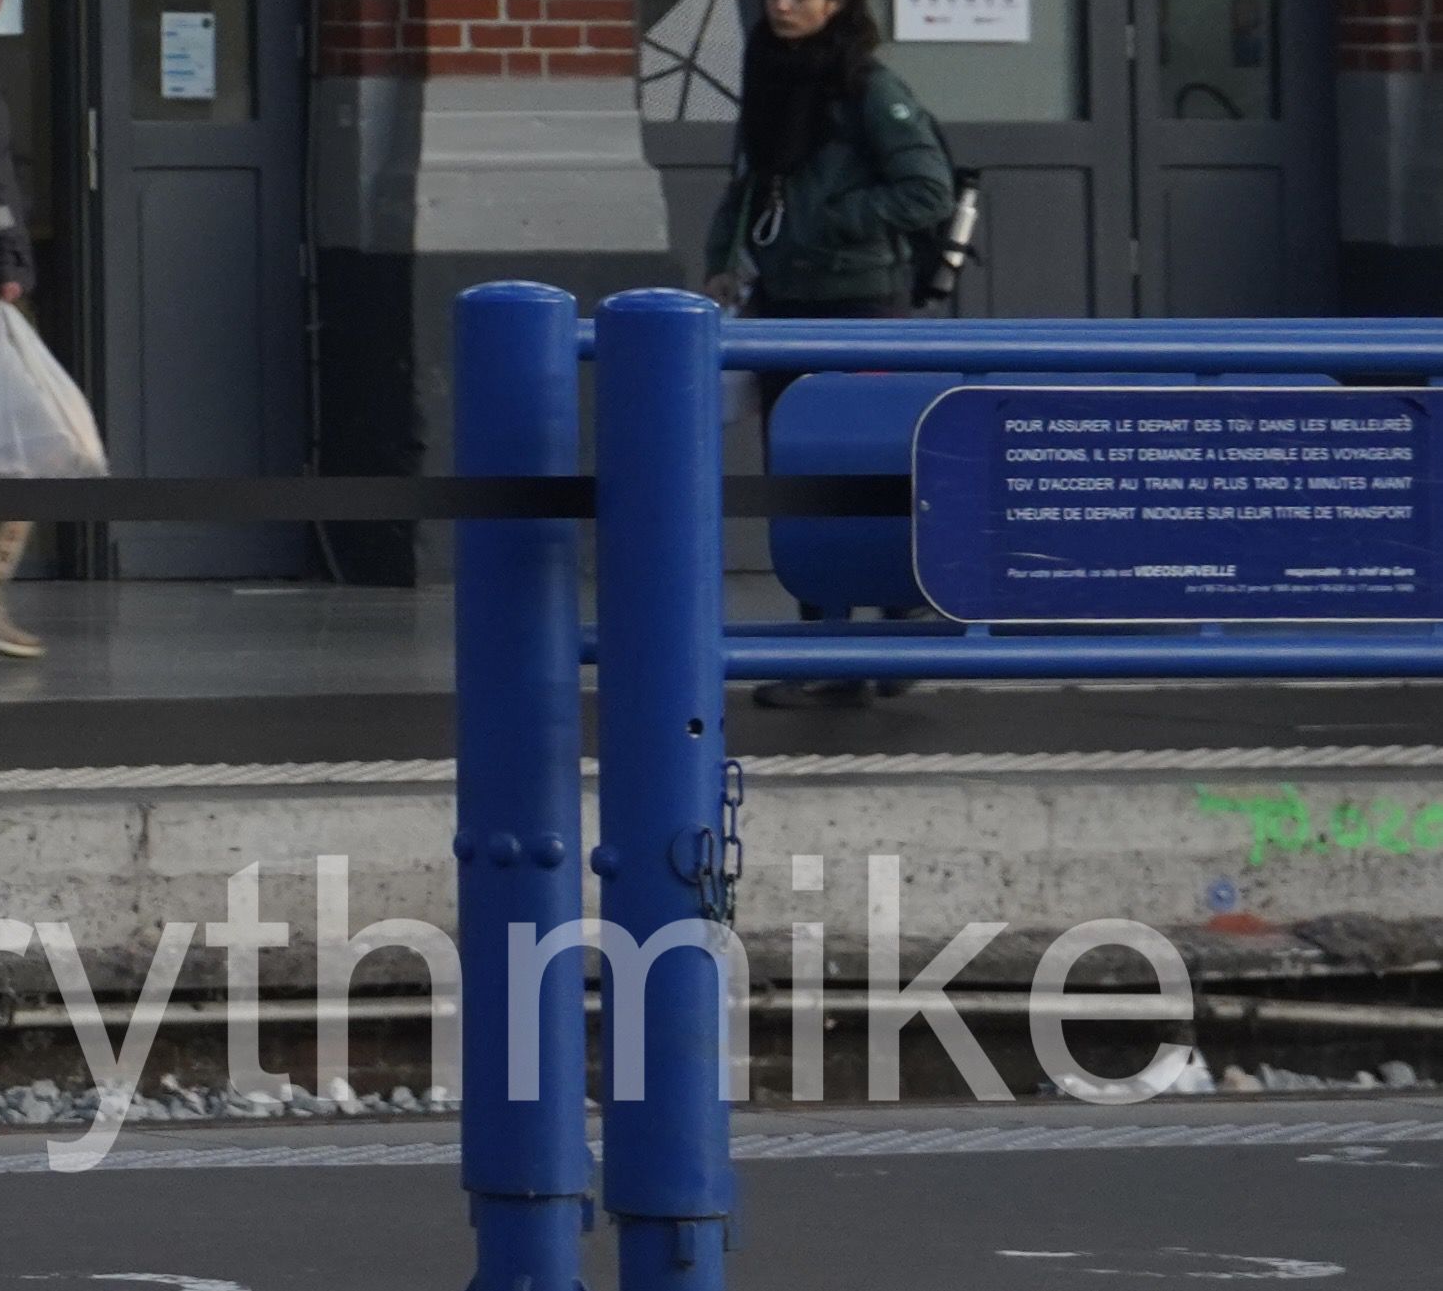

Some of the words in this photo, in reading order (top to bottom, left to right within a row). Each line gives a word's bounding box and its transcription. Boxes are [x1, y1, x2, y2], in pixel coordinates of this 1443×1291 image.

[1005, 419, 1043, 432] POUR
[1048, 419, 1111, 432] ASSURER
[1115, 419, 1133, 432] LE
[1137, 419, 1190, 432] DEPART
[1194, 419, 1222, 432] DES
[1227, 419, 1255, 432] TGV
[1259, 419, 1296, 432] DANS
[1300, 419, 1327, 432] LES
[1330, 419, 1413, 432] MEILLEURES
[1006, 447, 1090, 462] CONDITIONS,
[1093, 447, 1105, 462] IL
[1108, 447, 1135, 462] EST
[1138, 447, 1203, 462] DEMANDE
[1204, 447, 1216, 462] A
[1218, 447, 1298, 462] L'ENSEMBLE
[1301, 447, 1329, 462] DES
[1333, 447, 1413, 462] VOYAGEURS
[1006, 476, 1034, 491] TGV
[1038, 476, 1115, 491] D'ACCEDER
[1119, 476, 1139, 491] AU
[1144, 476, 1184, 491] TRAIN
[1188, 476, 1208, 491] AU
[1213, 476, 1248, 491] PLUS
[1253, 476, 1289, 491] TARD
[1294, 476, 1303, 491] 2
[1308, 476, 1367, 491] MINUTES
[1372, 476, 1413, 491] AVANT
[1006, 506, 1061, 521] L'HEURE
[1063, 506, 1082, 521] DE
[1084, 506, 1136, 521] DEPART
[1142, 506, 1205, 521] INDIQUEE
[1205, 506, 1235, 521] SUR
[1237, 506, 1272, 521] LEUR
[1274, 506, 1312, 521] TITRE
[1314, 506, 1333, 521] DE
[1336, 506, 1413, 521] TRANSPORT
